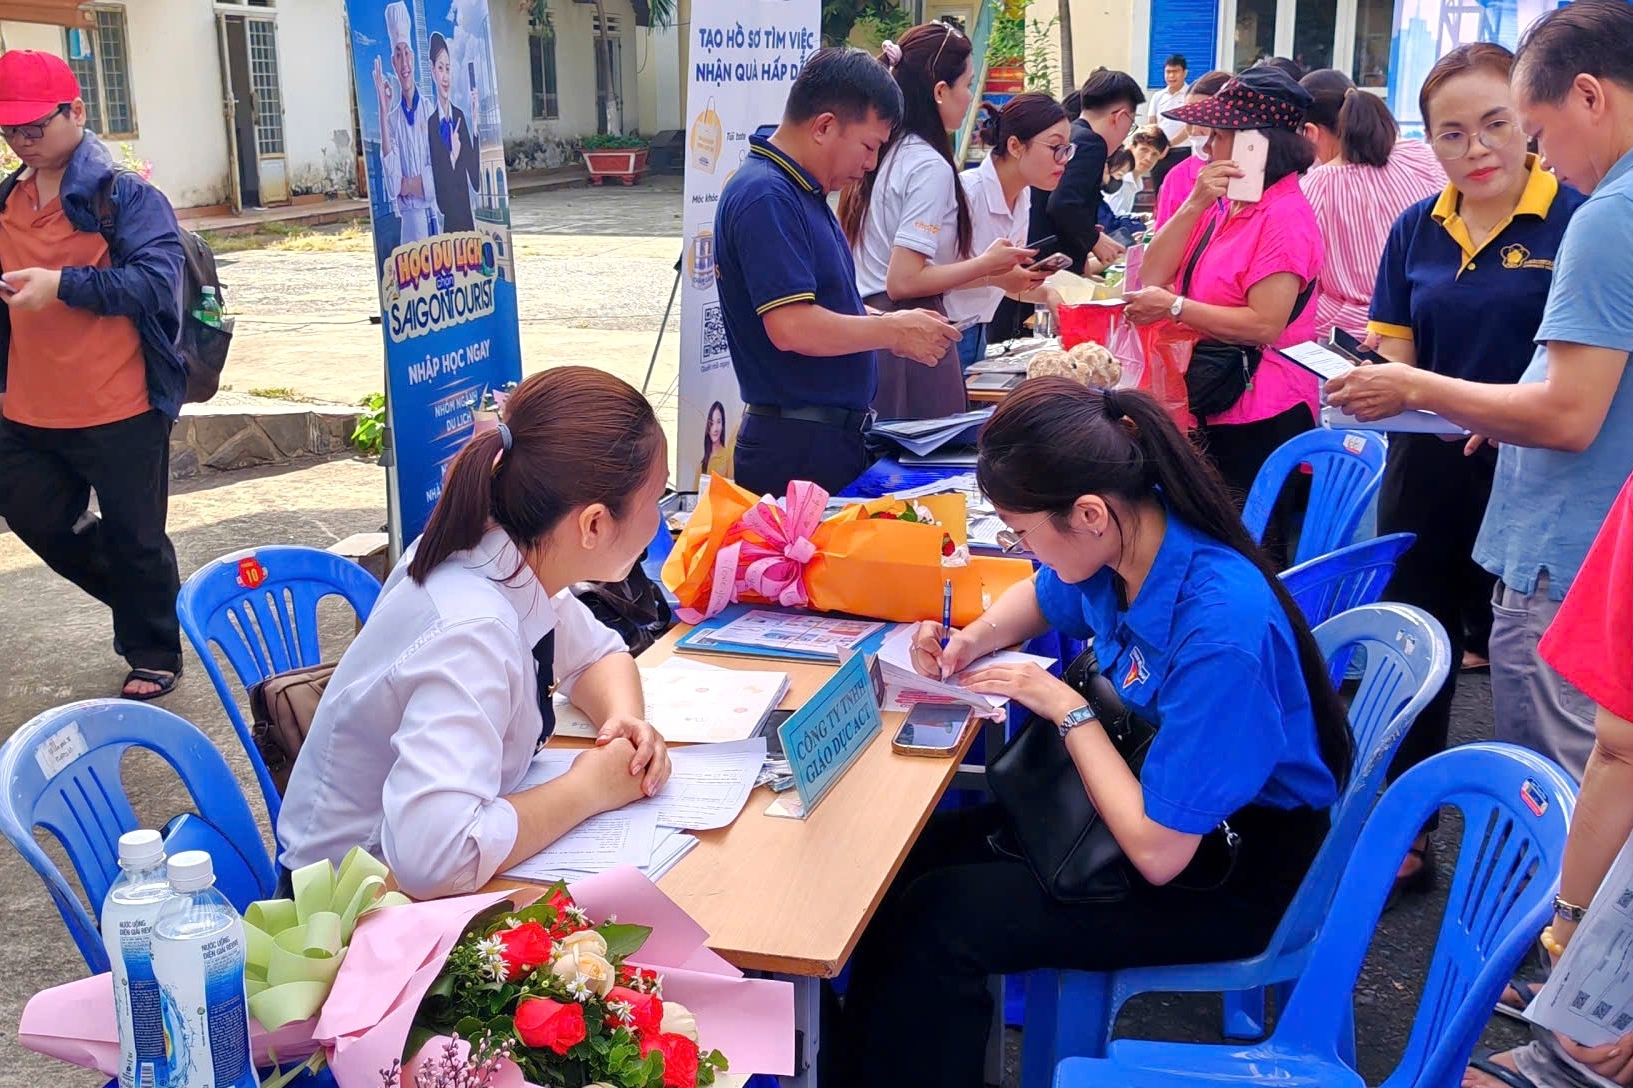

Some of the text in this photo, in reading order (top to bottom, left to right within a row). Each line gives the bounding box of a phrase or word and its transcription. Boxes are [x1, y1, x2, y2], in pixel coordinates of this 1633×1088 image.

[699, 21, 814, 55] TẠO HỒ SƠ TÌM VIỆC
[696, 58, 732, 87] NHẬN
[735, 59, 759, 82] QUÀ
[762, 56, 788, 81] HẤP
[395, 237, 482, 291] HỌC DU LỊCH
[391, 279, 493, 336] SAIGONTOURIST
[408, 339, 491, 386] NHẬP HỌC NGAY
[246, 568, 259, 583] 10
[796, 677, 867, 761] CÔNG TY TNHH
[806, 745, 833, 784] GIÁO
[832, 721, 854, 757] DỤC
